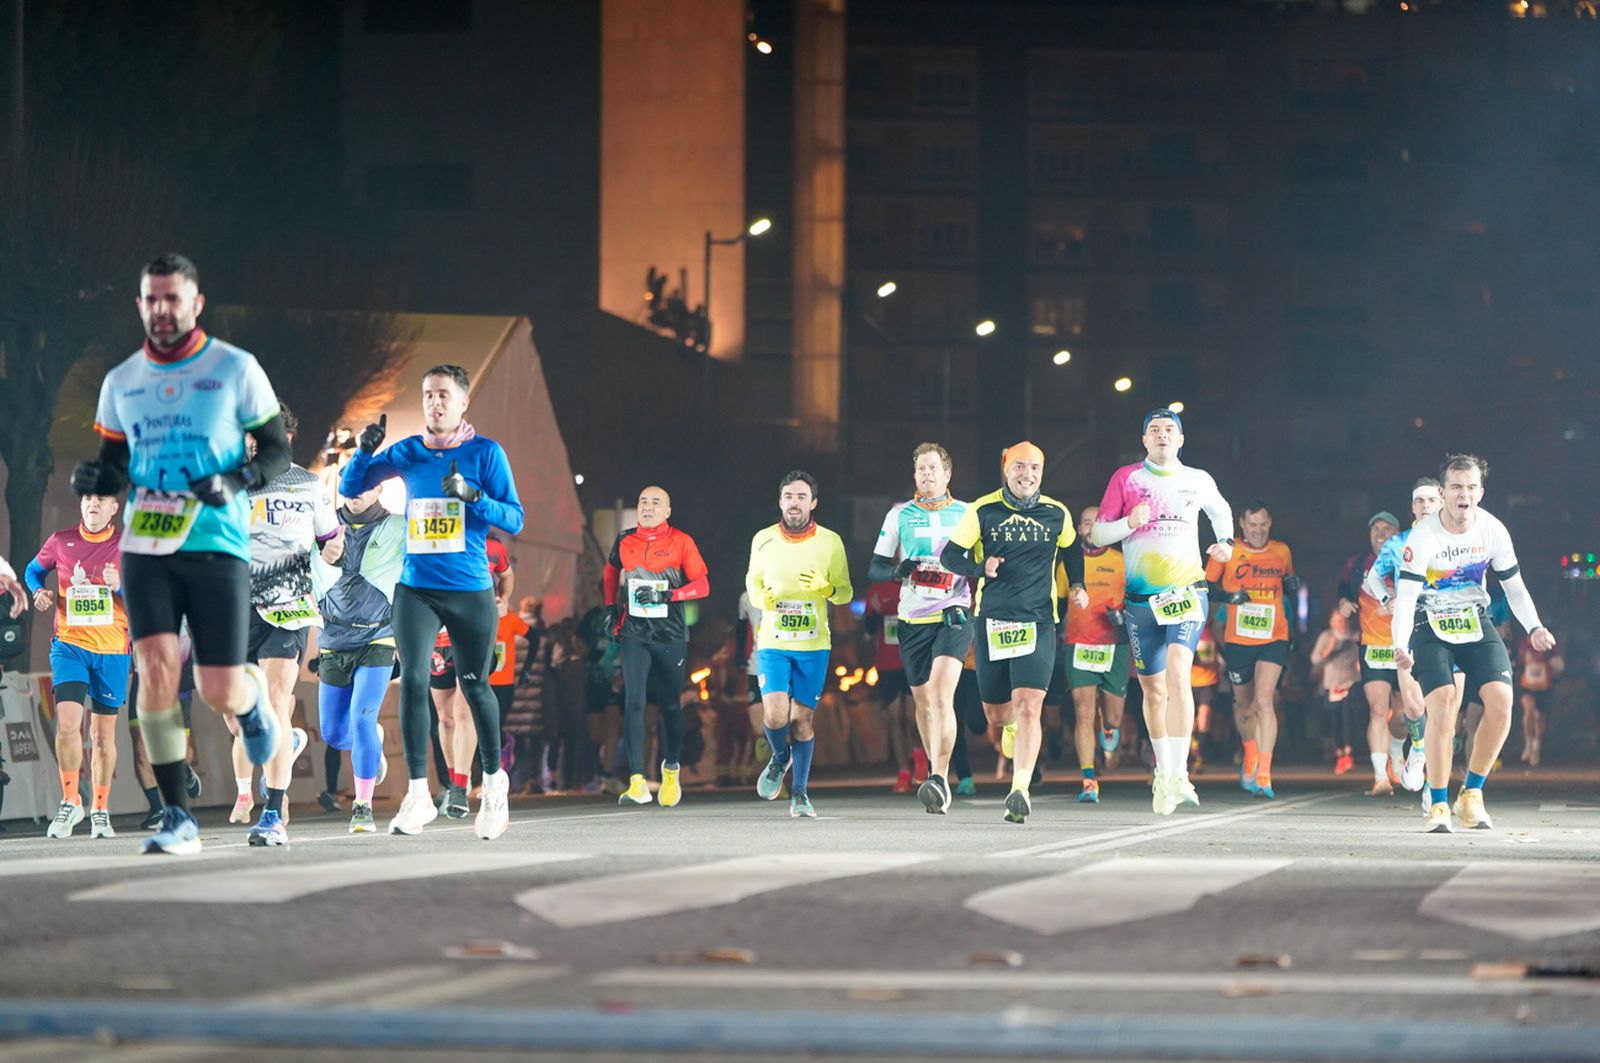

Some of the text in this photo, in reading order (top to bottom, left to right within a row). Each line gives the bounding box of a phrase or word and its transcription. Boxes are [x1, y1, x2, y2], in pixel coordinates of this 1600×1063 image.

[139, 511, 185, 533] 2363
[415, 517, 456, 535] 13457
[990, 531, 1050, 541] TRAIL
[75, 599, 105, 612] 6954
[1162, 599, 1192, 616] 9270
[781, 614, 810, 627] 9574
[1243, 614, 1268, 628] 4425
[998, 628, 1028, 645] 1622
[1372, 648, 1394, 659] 566
